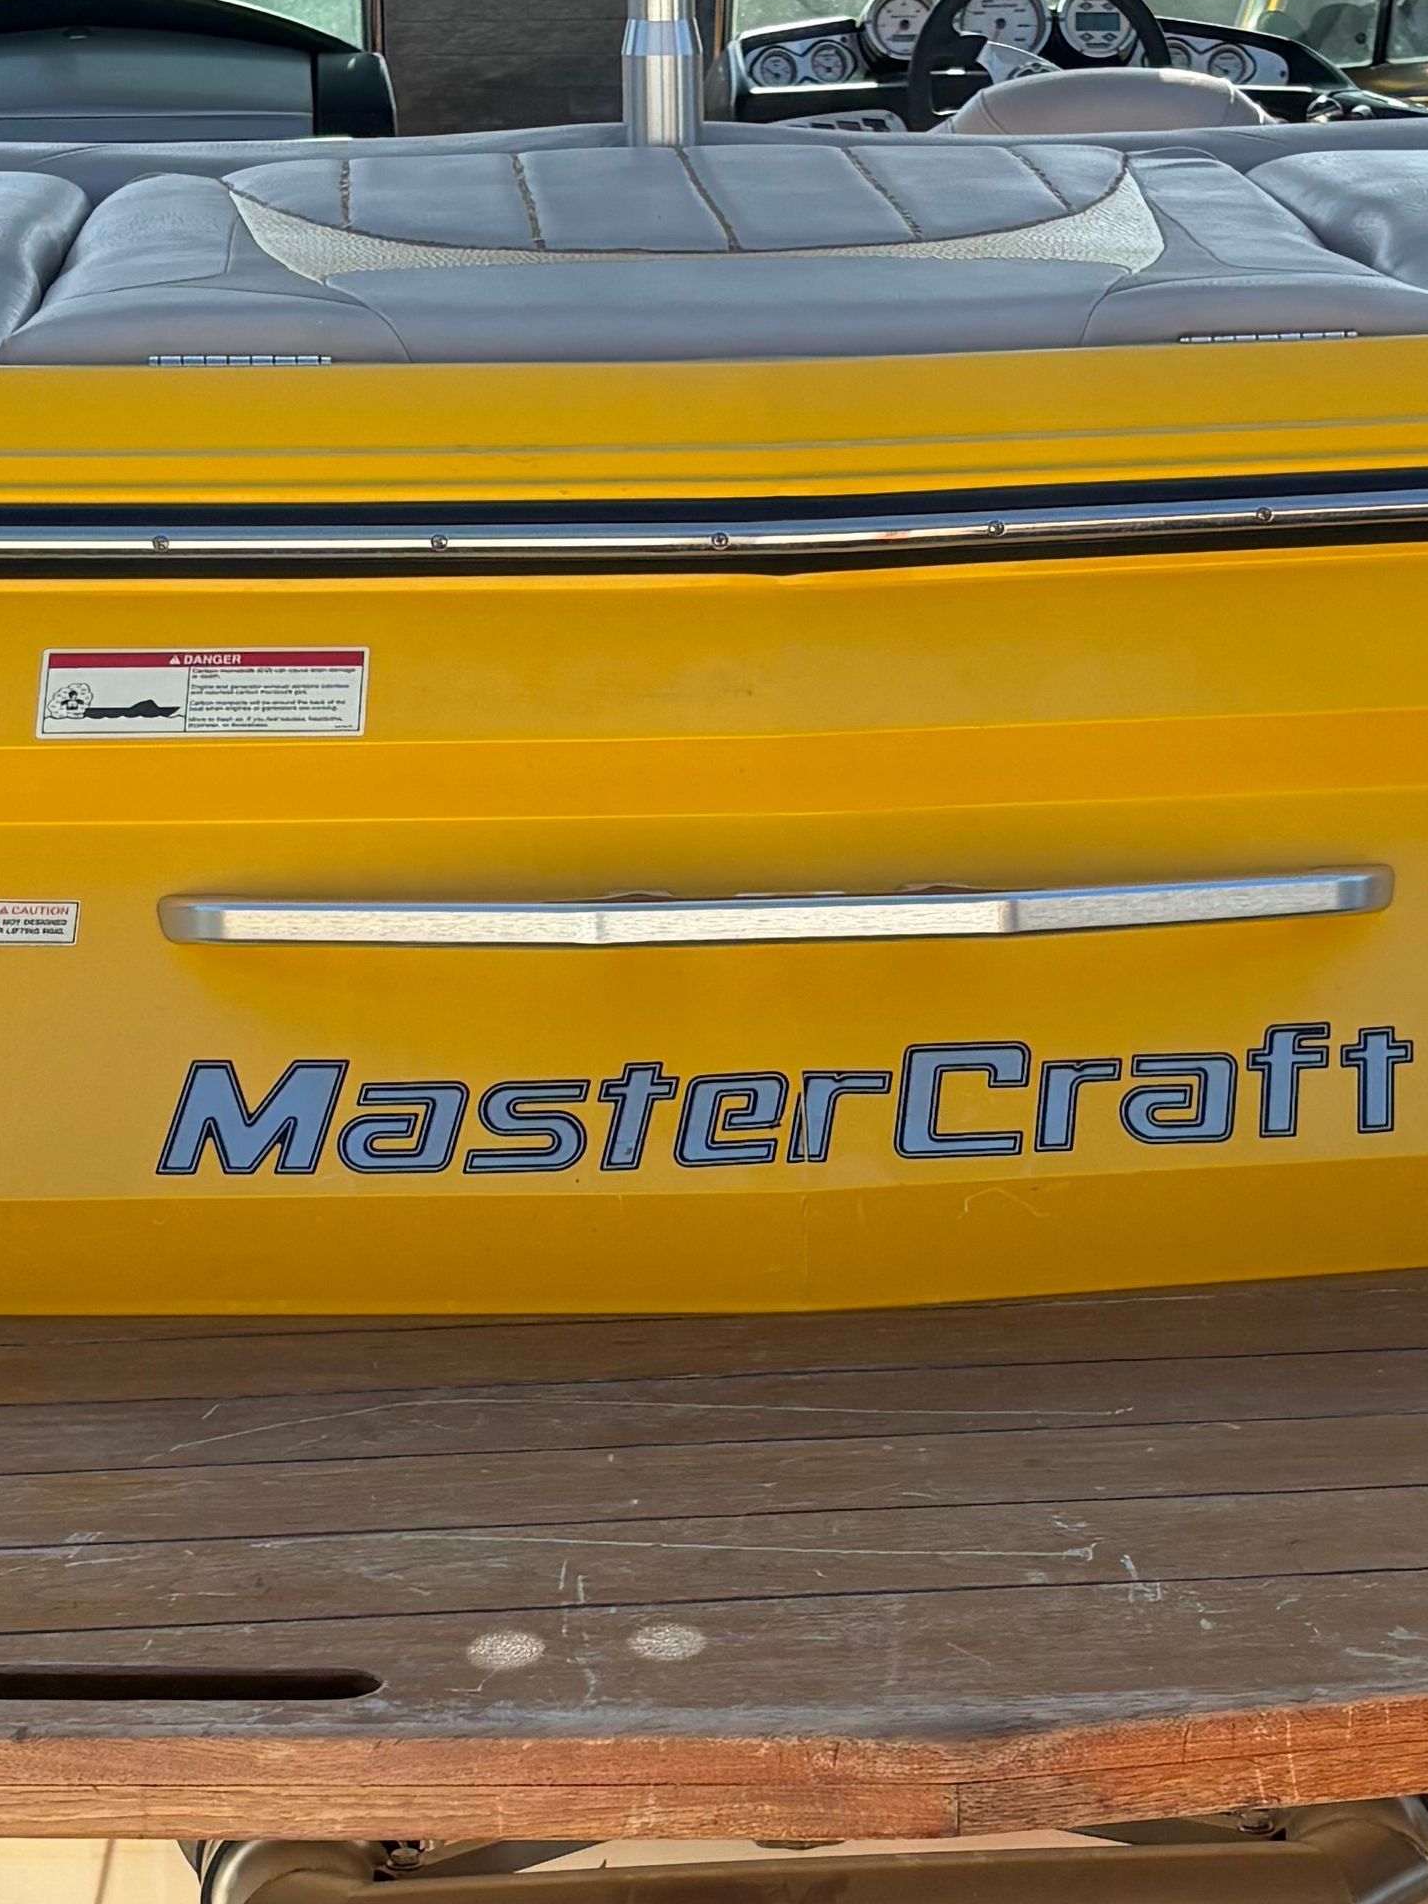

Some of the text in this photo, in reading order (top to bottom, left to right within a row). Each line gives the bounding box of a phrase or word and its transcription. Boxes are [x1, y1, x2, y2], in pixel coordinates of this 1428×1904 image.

[183, 654, 242, 666] DANGER
[11, 906, 70, 916] CAUTION
[2, 918, 21, 926] NOT
[155, 1023, 1414, 1175] MasterCraft
